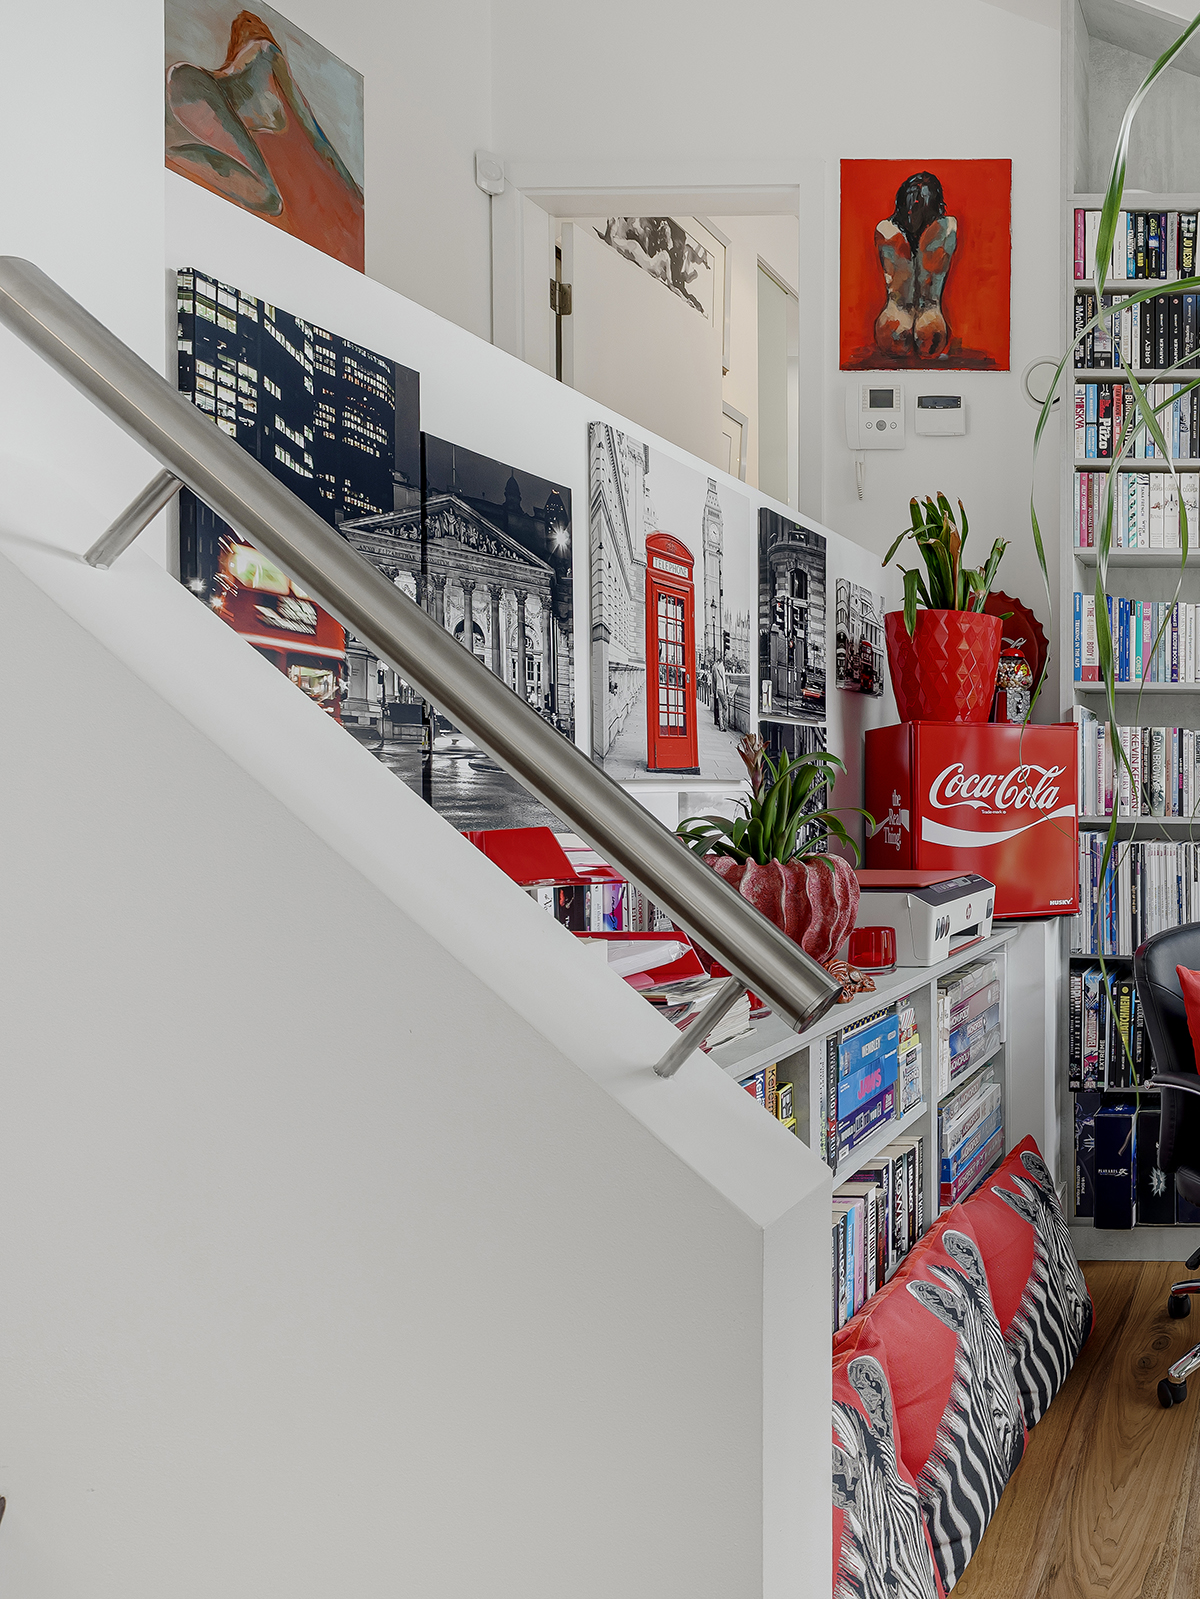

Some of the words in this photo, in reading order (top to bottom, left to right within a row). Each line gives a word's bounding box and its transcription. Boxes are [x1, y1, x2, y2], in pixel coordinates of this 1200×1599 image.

[1099, 417, 1112, 450] Puzo
[1086, 607, 1094, 618] THE
[1086, 618, 1094, 641] 4-HOUR
[1086, 641, 1094, 657] BODY
[1131, 733, 1140, 764] KEVIN
[1152, 735, 1162, 753] DAN
[1152, 754, 1162, 784] BROWN
[891, 789, 902, 807] the
[928, 762, 1068, 810] Coca-Cola
[1131, 766, 1140, 809] KEEGAN
[888, 808, 902, 826] Real
[857, 1068, 882, 1100] JAWS
[895, 1166, 904, 1229] BOWIE
